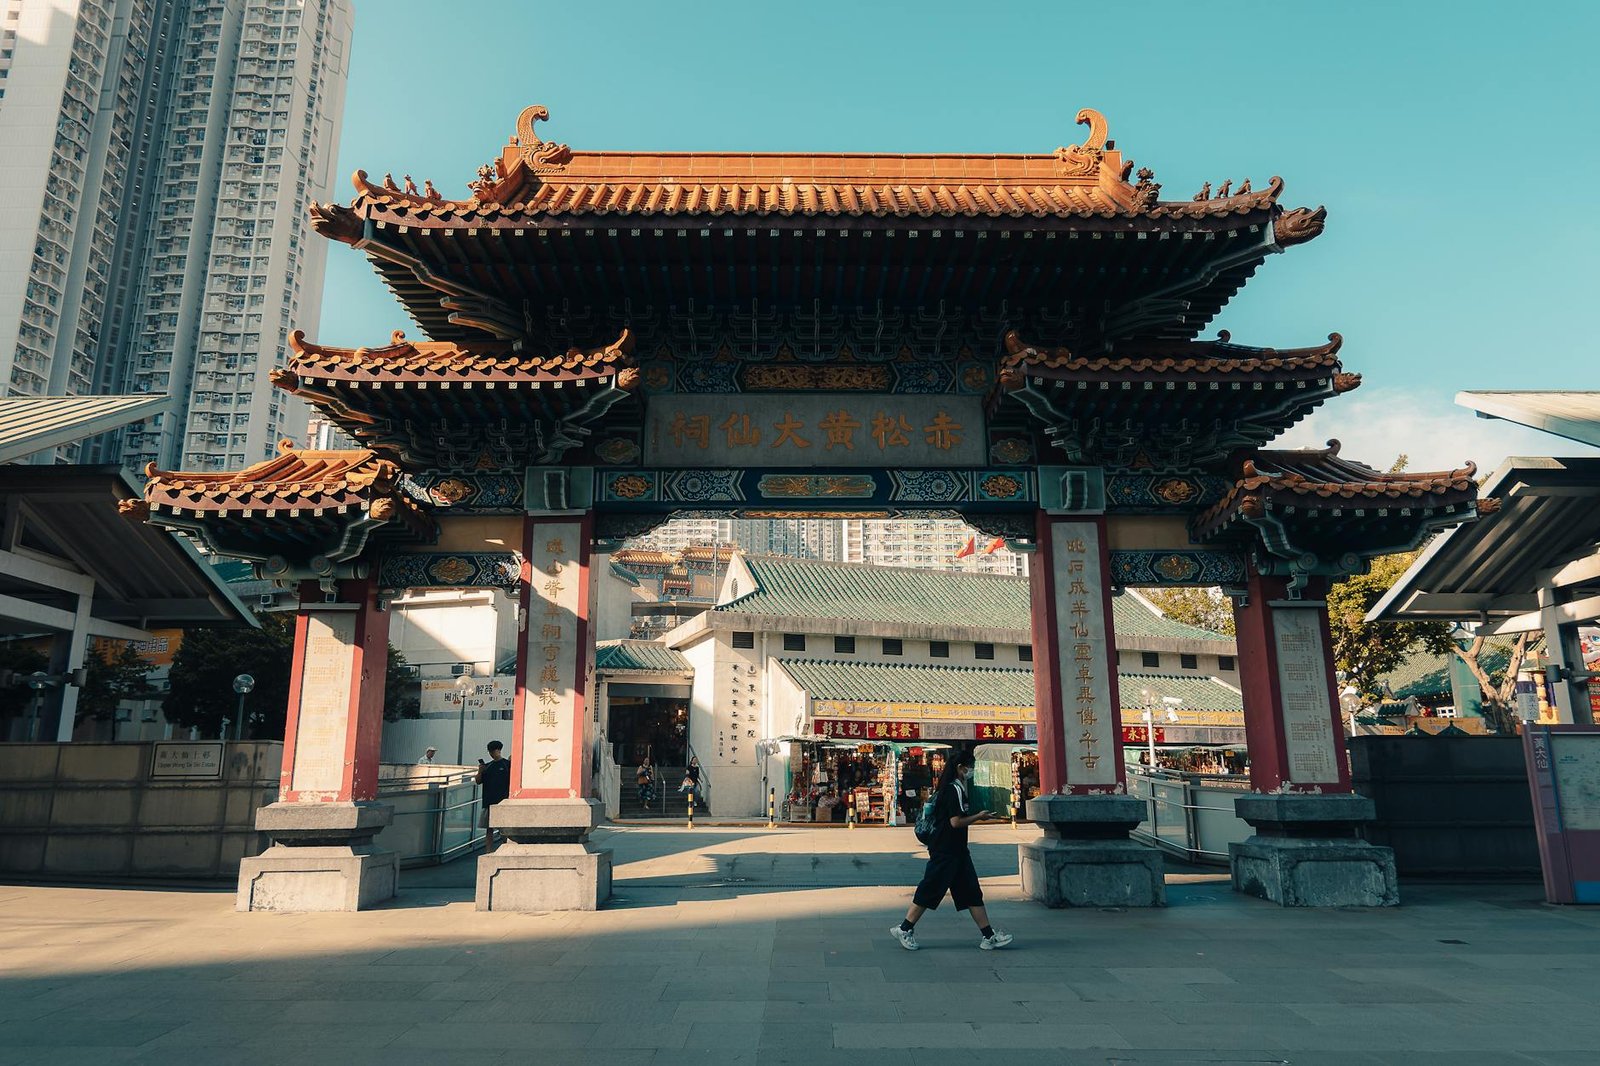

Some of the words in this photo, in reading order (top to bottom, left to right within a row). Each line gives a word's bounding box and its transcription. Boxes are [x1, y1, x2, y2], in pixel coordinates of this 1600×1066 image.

[668, 408, 965, 453] 赤松黃大仙祠
